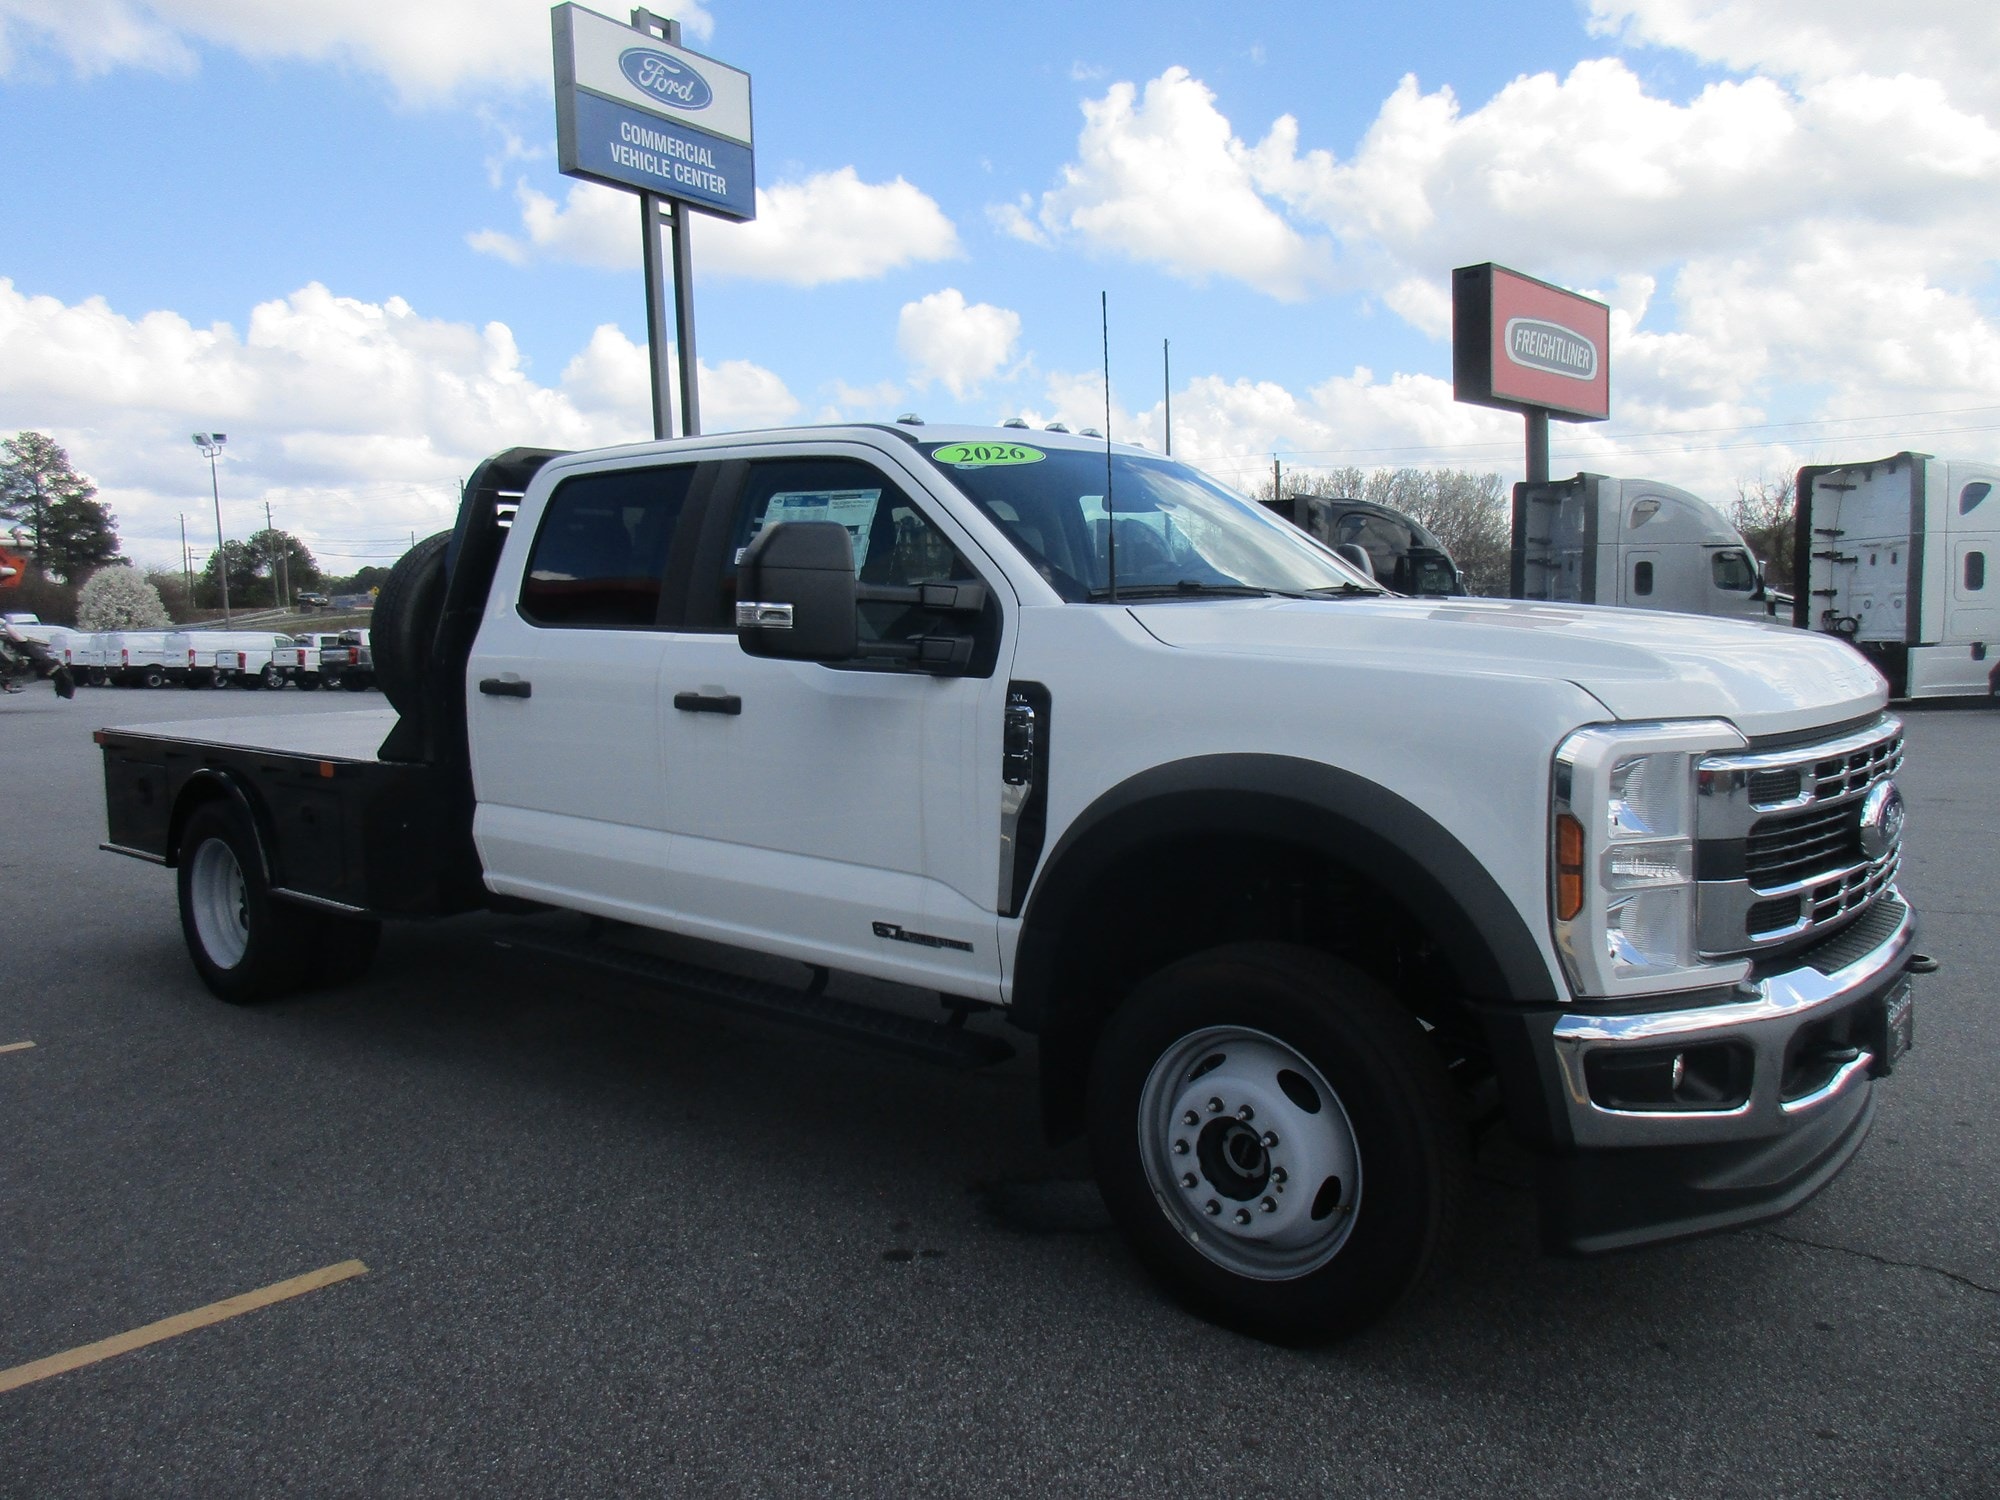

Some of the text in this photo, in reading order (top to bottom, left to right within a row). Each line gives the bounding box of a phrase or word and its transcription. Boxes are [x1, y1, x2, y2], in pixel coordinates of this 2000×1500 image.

[638, 57, 694, 102] Ford
[620, 121, 716, 169] COMMERCIAL
[610, 142, 727, 196] VEHICLE CENTER
[1515, 328, 1590, 370] FREIGHTLINER
[955, 446, 1026, 463] 2026
[1012, 693, 1028, 703] XL
